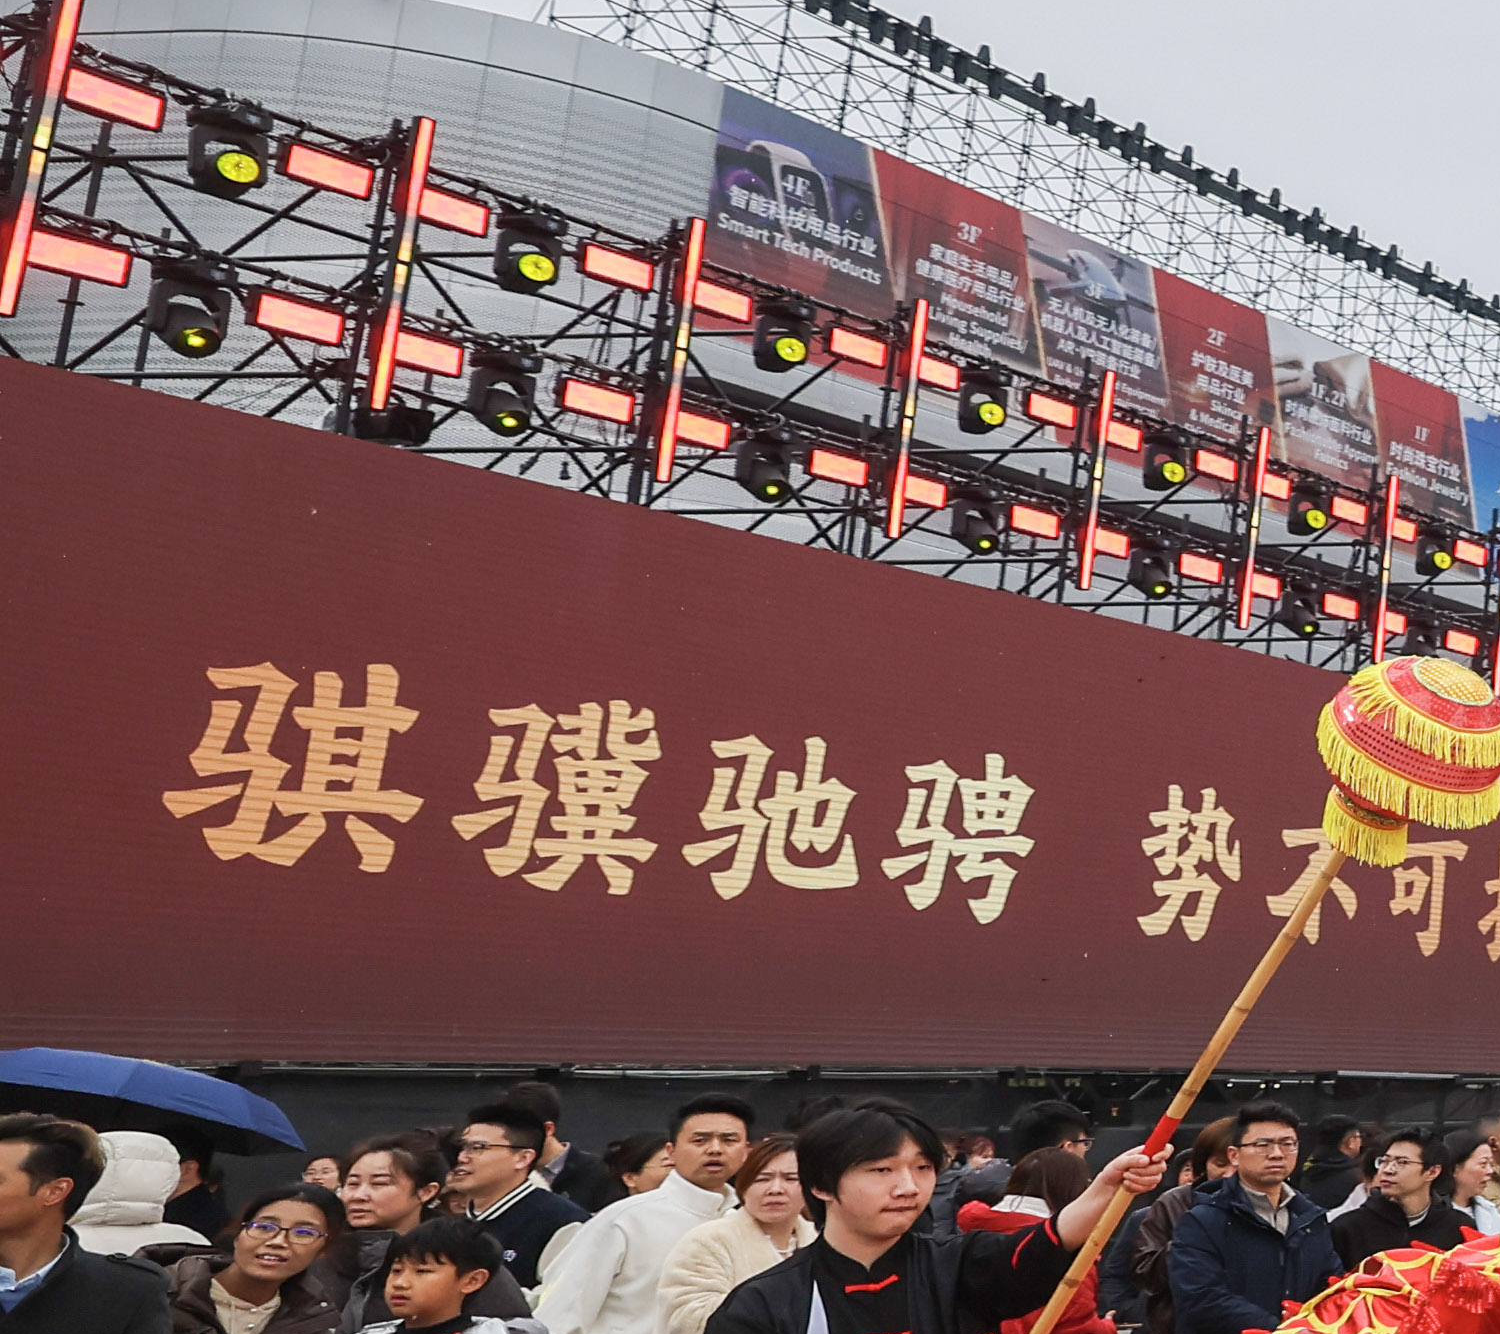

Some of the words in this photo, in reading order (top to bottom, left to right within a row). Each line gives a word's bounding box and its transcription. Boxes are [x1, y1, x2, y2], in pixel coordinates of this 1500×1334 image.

[728, 184, 878, 259] 智能科技用品行业
[956, 222, 983, 244] 3F
[716, 212, 770, 245] Smart
[773, 231, 811, 260] Tech
[812, 242, 882, 285] Products
[928, 305, 968, 335] Living
[940, 291, 1009, 328] Household
[1206, 327, 1228, 347] 2F
[1196, 372, 1247, 405] 用品行业
[1385, 461, 1428, 488] Fashion
[1428, 478, 1470, 507] Jewelry
[161, 661, 1037, 924] 骐骥驰骋
